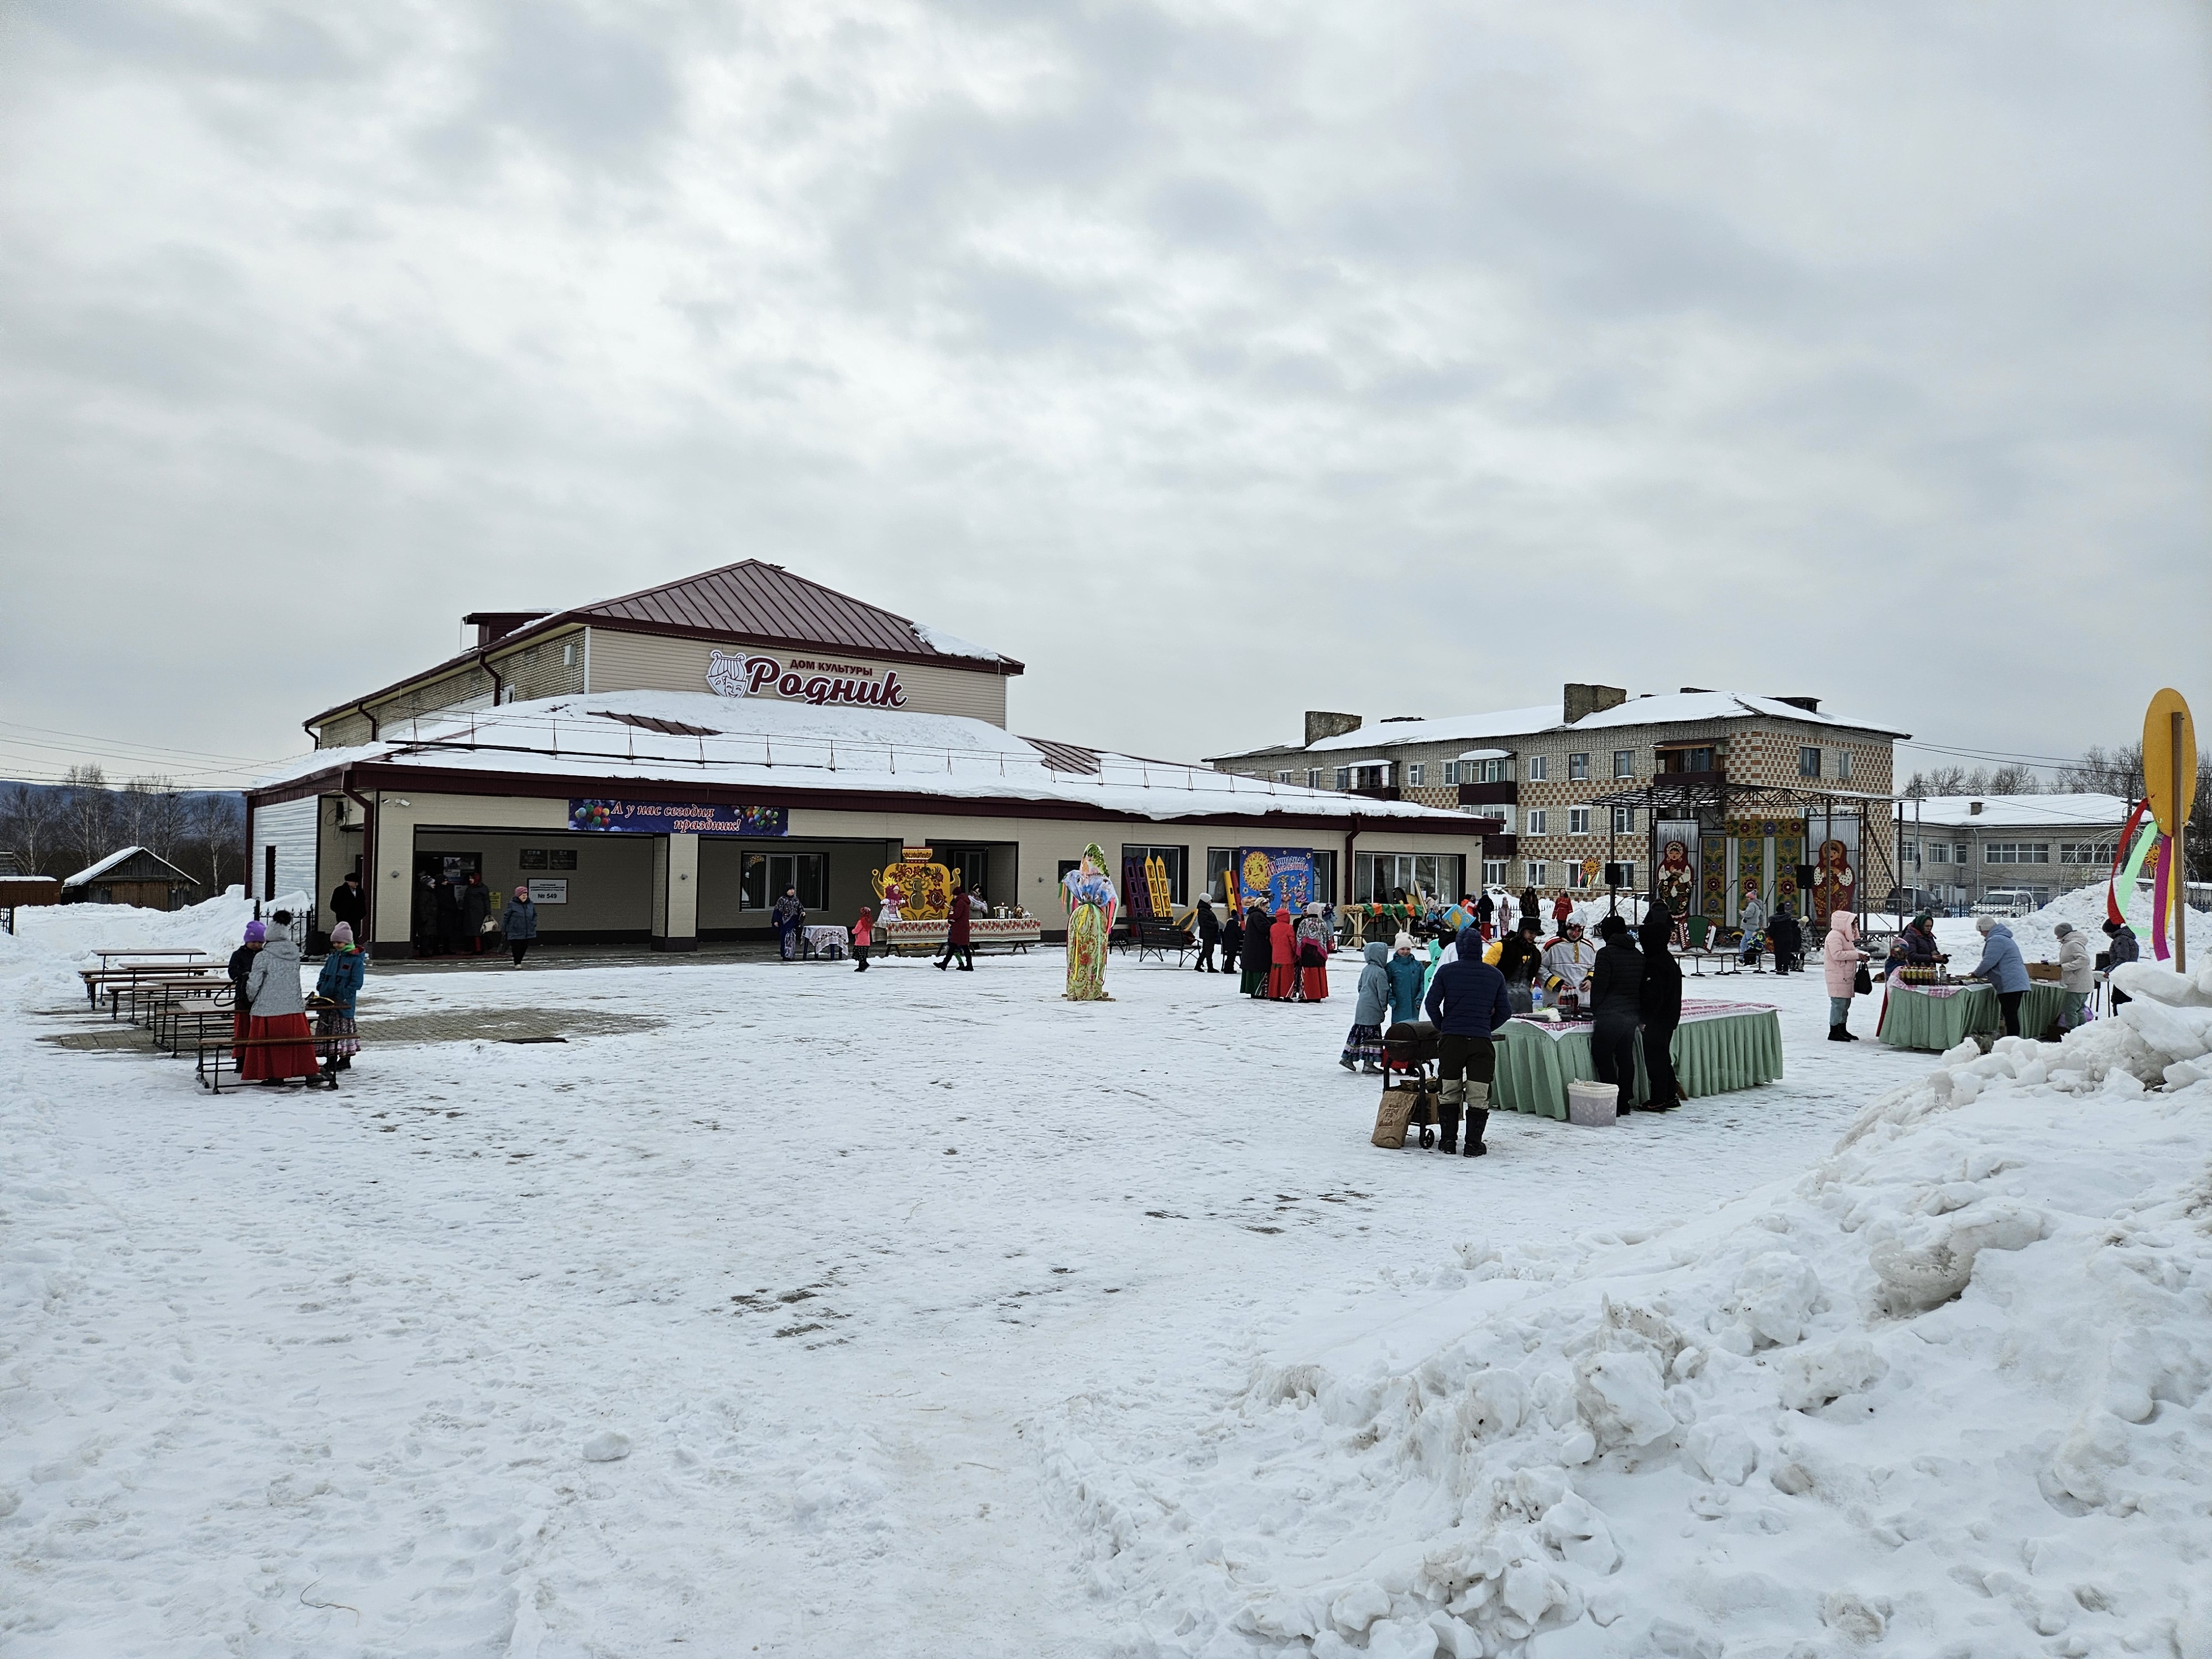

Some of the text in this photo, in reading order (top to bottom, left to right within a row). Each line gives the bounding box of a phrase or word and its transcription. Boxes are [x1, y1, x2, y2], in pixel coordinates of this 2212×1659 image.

[790, 659, 873, 676] ДОМ КУЛЬТУРЫ
[745, 656, 908, 706] Родник
[611, 801, 714, 818] А у нас сегодня
[674, 818, 741, 833] праздник!
